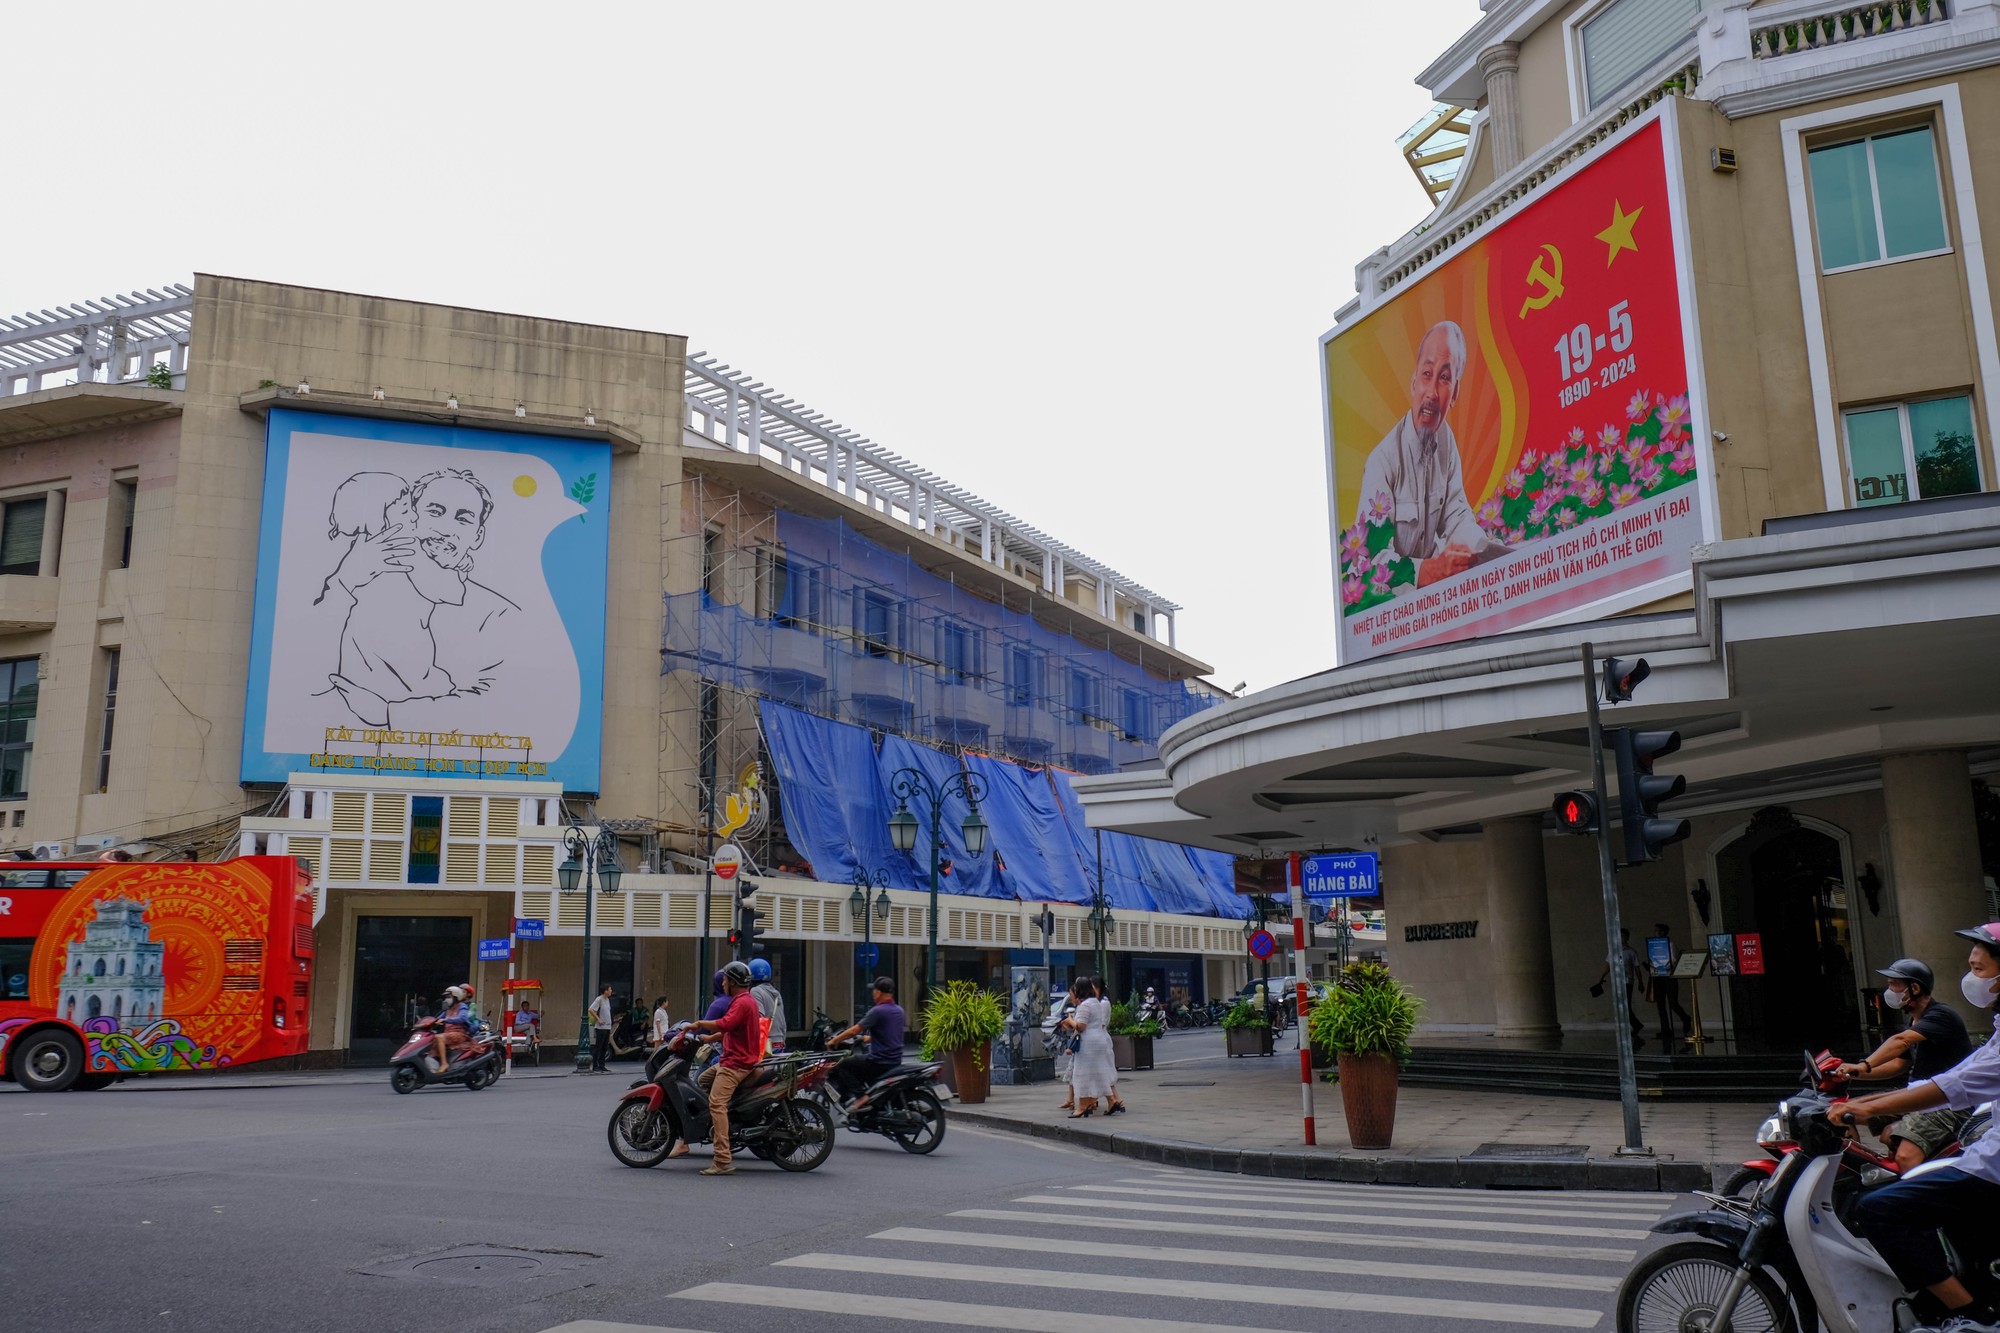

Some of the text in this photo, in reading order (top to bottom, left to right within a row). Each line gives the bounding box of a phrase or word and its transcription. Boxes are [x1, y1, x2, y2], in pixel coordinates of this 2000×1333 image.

[1558, 377, 1591, 409] 1890
[1600, 353, 1636, 389] 2024
[1353, 496, 1690, 636] NHIỆT LIỆT CHÀO MỪNG 134 NĂM NGÀY SINH CHỦ TỊCH HỒ CHÍ MINH VĨ ĐẠI
[1371, 530, 1663, 647] ANH HÙNG GIẢI PHÓNG DÂN TỘC, DANH NHÂN VĂN HÓA THẾ GIỚI!
[326, 725, 355, 741] XÂY
[410, 731, 432, 748] LẠI
[438, 728, 463, 747] ĐẤT
[518, 736, 533, 750] TA
[463, 760, 480, 773] TO
[1333, 857, 1357, 869] PHỐ
[1308, 872, 1372, 892] HÀNG BÀI
[1404, 920, 1479, 943] BURBERRY
